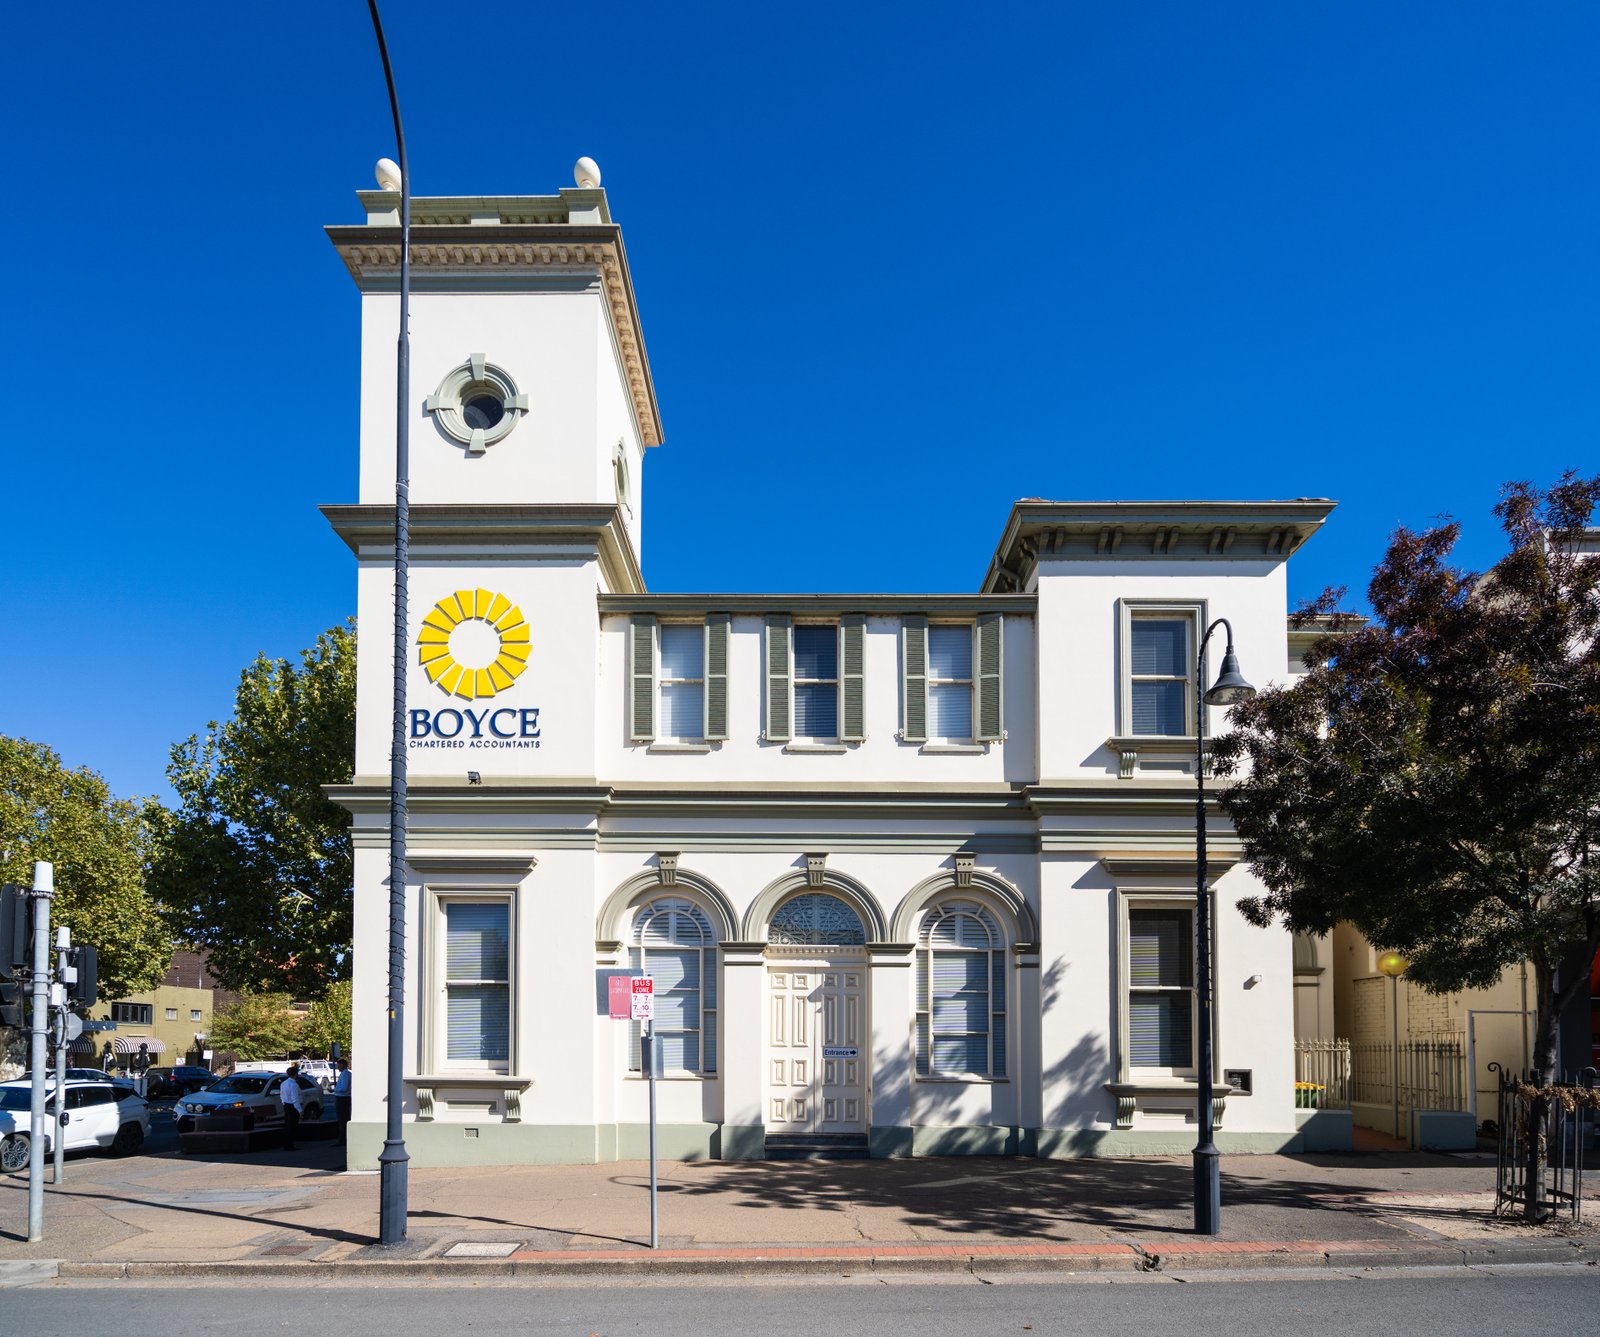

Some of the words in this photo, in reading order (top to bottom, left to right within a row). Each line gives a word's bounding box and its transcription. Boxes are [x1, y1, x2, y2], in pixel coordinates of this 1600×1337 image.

[409, 708, 541, 739] BOYCE
[409, 740, 465, 749] CHARTERED
[469, 740, 541, 749] ACCOUNTANTS
